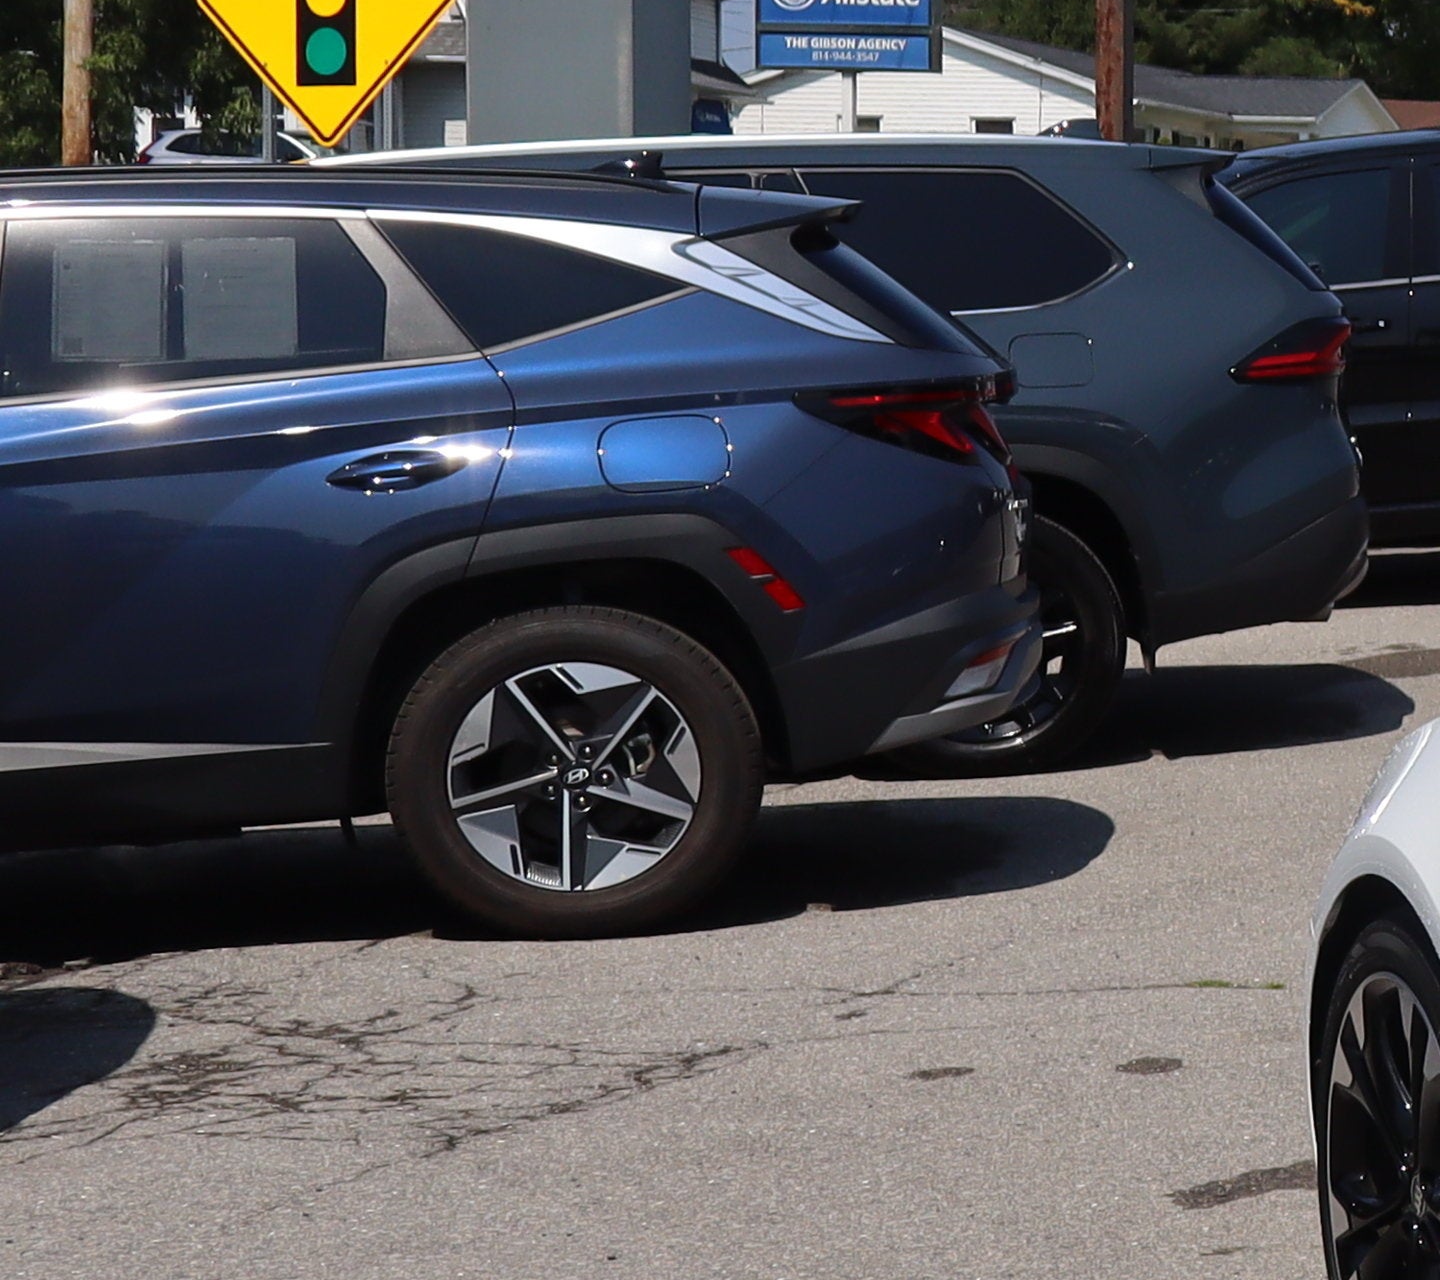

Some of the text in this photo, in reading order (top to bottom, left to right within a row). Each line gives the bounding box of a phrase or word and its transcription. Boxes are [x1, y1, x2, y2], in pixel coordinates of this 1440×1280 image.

[785, 36, 907, 52] THE GIBSON AGENCY
